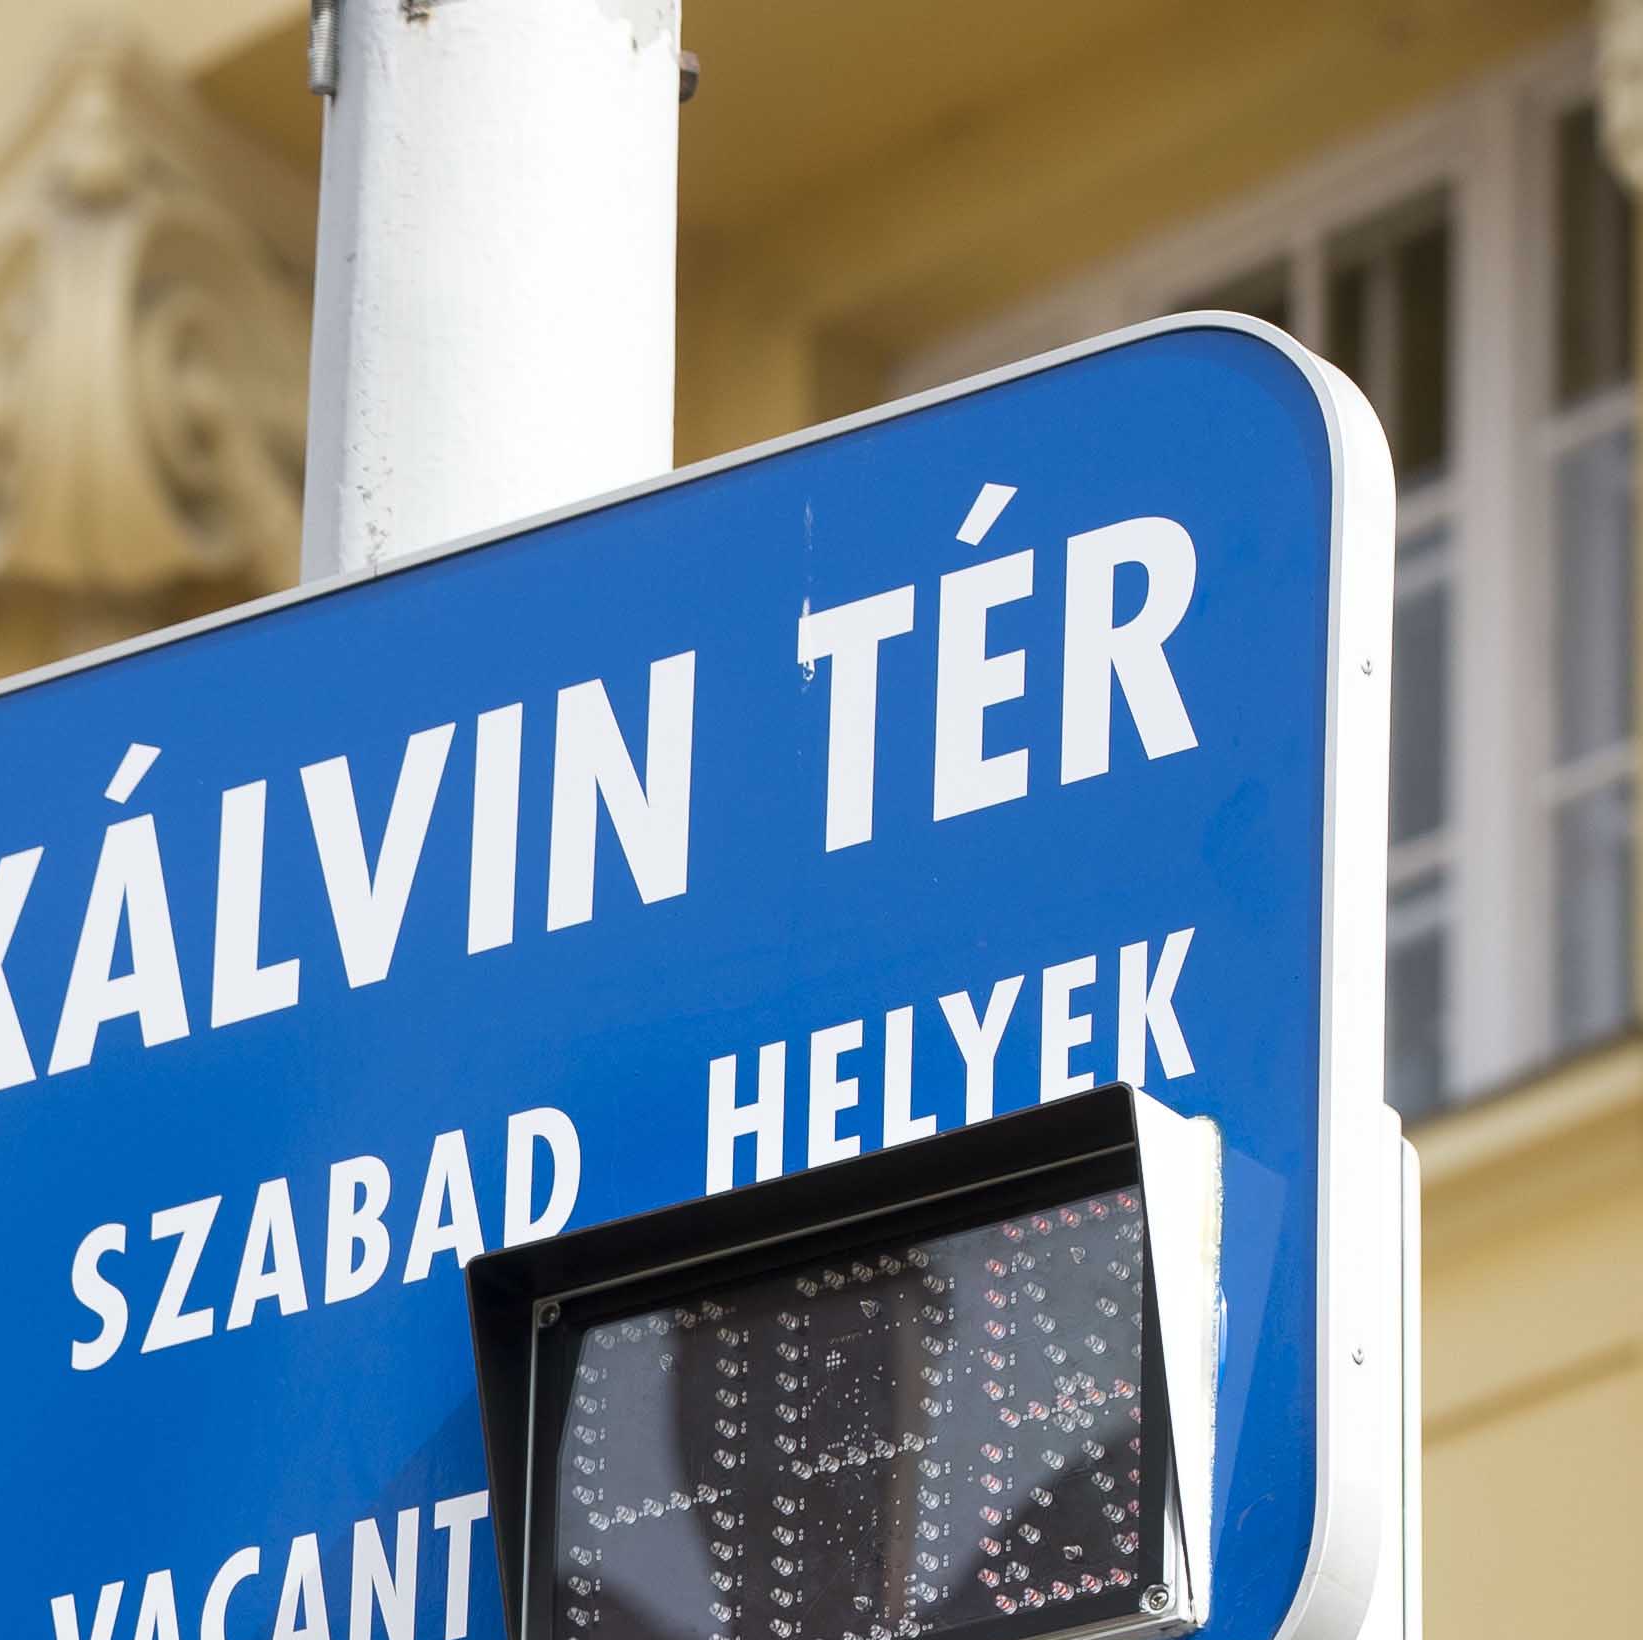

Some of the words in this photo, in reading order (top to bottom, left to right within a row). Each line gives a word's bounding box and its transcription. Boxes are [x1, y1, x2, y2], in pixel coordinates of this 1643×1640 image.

[797, 482, 1199, 853] TÉR
[71, 1107, 581, 1371] SZABAD
[705, 927, 1197, 1197] HELYEK
